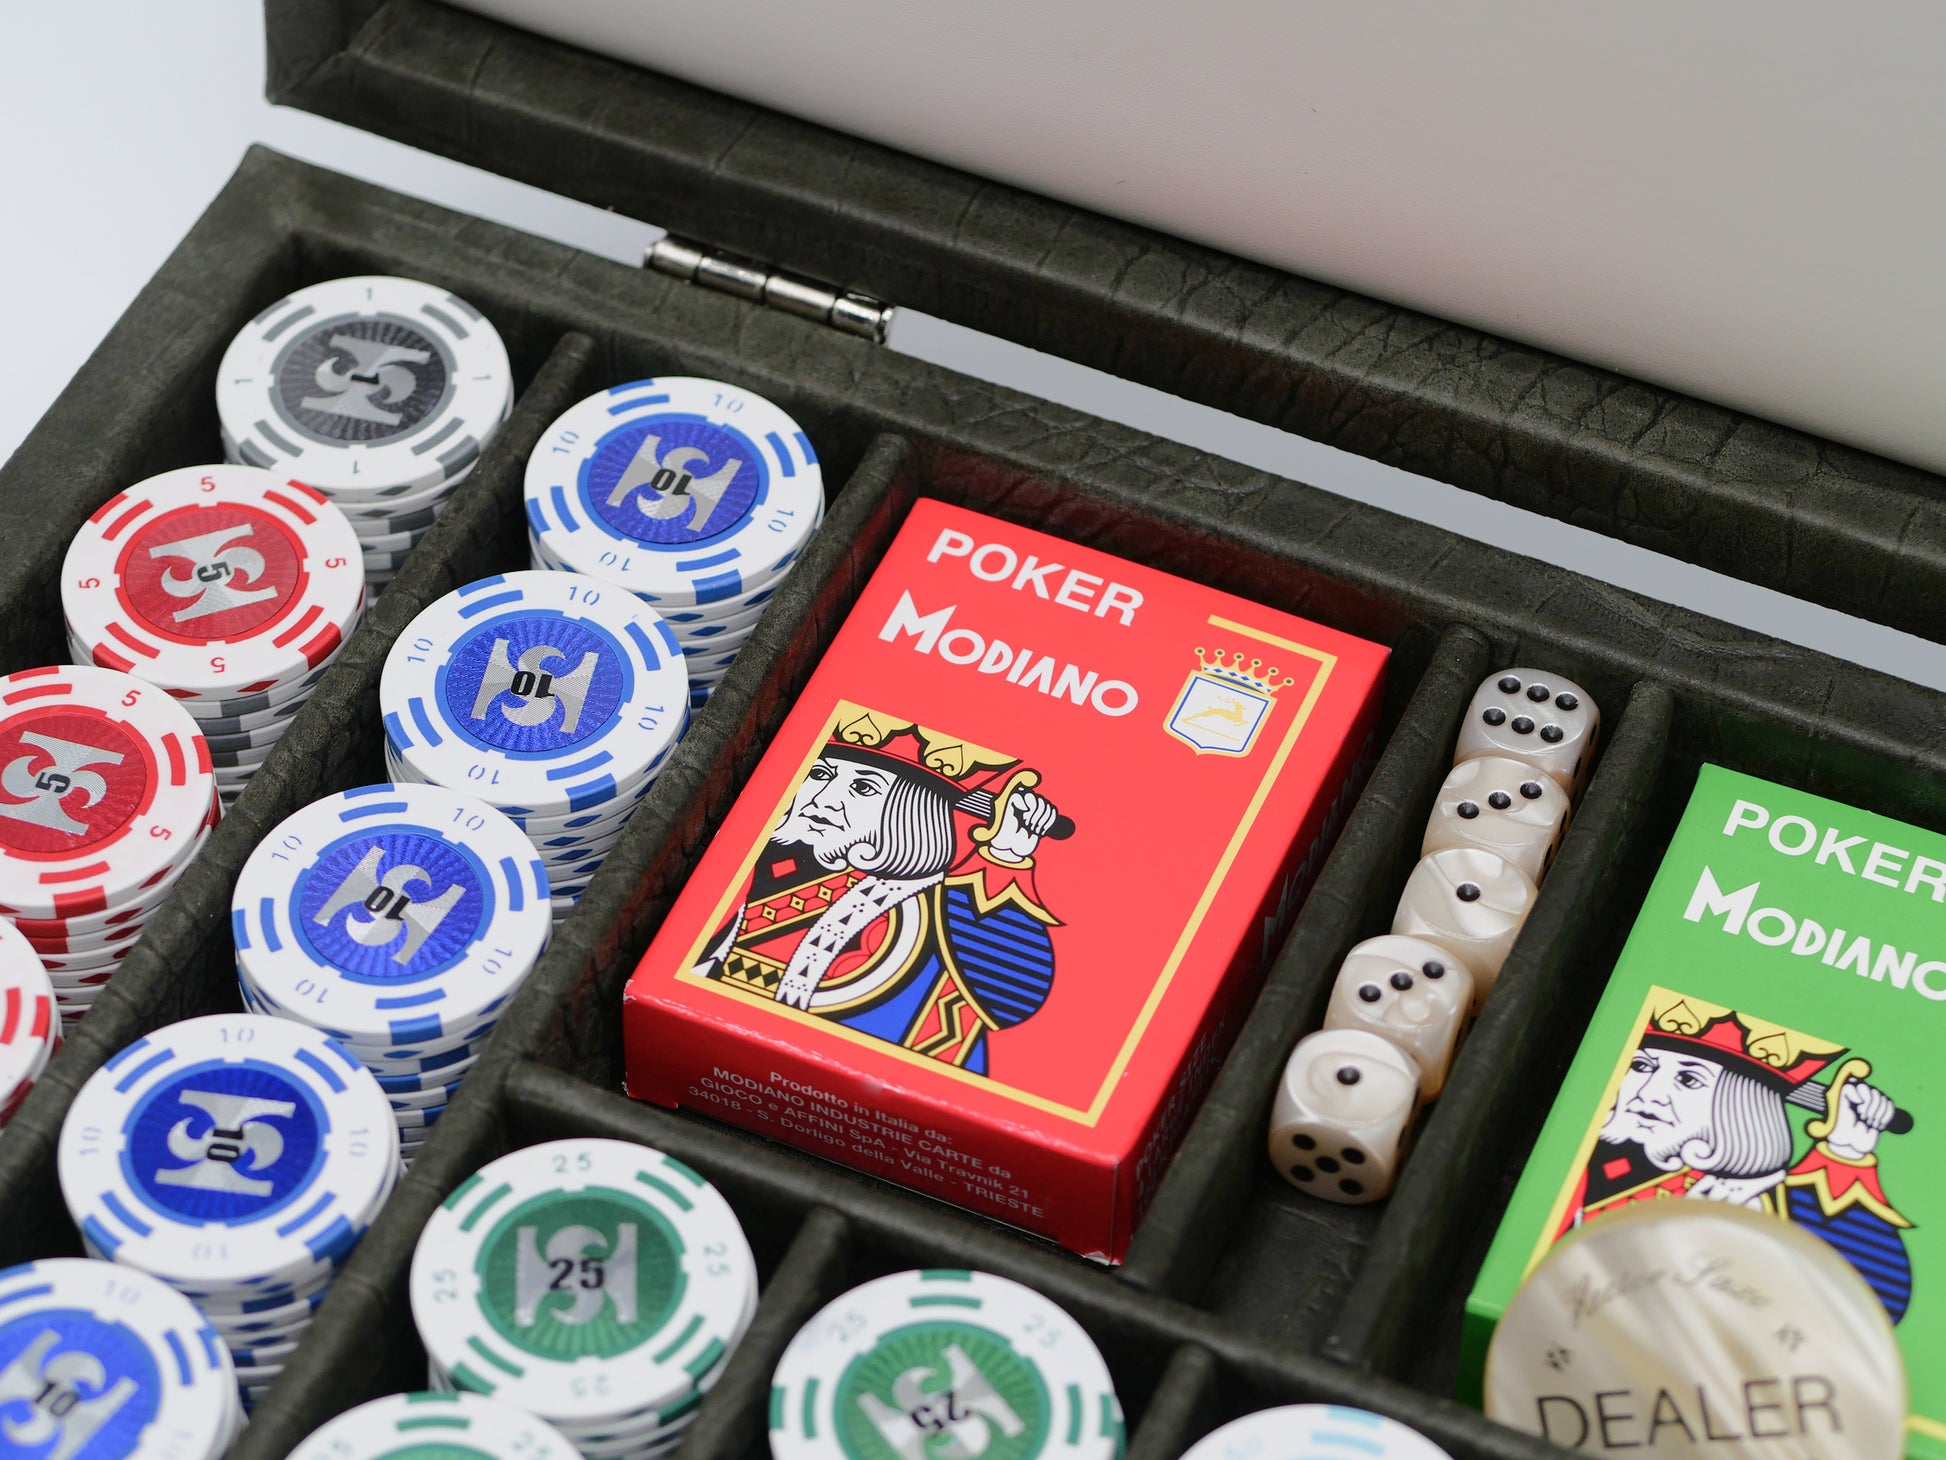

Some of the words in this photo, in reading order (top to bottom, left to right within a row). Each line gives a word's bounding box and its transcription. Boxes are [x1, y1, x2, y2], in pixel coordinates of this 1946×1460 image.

[366, 287, 374, 302] 1
[714, 392, 746, 414] 10
[552, 430, 581, 455] 10
[353, 460, 360, 475] 1
[201, 476, 216, 493] 5
[650, 468, 693, 498] 10
[768, 510, 795, 533] 10
[197, 561, 231, 583] 5
[325, 558, 347, 569] 5
[599, 552, 631, 572] 10
[79, 578, 101, 589] 5
[926, 528, 1144, 627] POKER
[569, 586, 601, 606] 10
[407, 638, 434, 663] 10
[878, 589, 1139, 717] MODIANO
[210, 657, 226, 674] 5
[509, 670, 556, 699] 10
[121, 690, 142, 708] 5
[638, 706, 665, 731] 10
[35, 772, 71, 794] 5
[468, 765, 500, 785] 10
[454, 808, 487, 832] 10
[150, 825, 173, 841] 5
[273, 835, 304, 862] 10
[1722, 799, 1946, 903] POKER
[363, 887, 413, 921] 10
[1683, 865, 1946, 1001] MODIANO
[482, 949, 513, 975] 10
[295, 979, 329, 1004] 10
[220, 1028, 256, 1045] 10
[770, 1072, 848, 1109] Prodotto
[853, 1102, 870, 1117] in
[875, 1110, 919, 1133] Italia
[924, 1129, 952, 1144] da:
[713, 1066, 805, 1107] MODIANO
[810, 1102, 913, 1145] INDUSTRIE
[918, 1140, 983, 1169] CARTE
[988, 1165, 1012, 1179] da
[79, 1126, 102, 1157] 10
[206, 1127, 245, 1164] 10
[700, 1077, 763, 1105] GIOCO
[768, 1102, 778, 1111] e
[784, 1107, 844, 1134] AFFINI
[849, 1128, 886, 1149] SpA
[903, 1147, 932, 1164] Via
[936, 1158, 1003, 1190] Travnik
[1009, 1185, 1029, 1199] 21
[552, 1152, 593, 1175] 25
[689, 1086, 742, 1111] 34018
[757, 1109, 775, 1122] S.
[780, 1117, 847, 1147] Dorligo
[851, 1143, 895, 1165] della
[901, 1159, 945, 1182] Valle
[963, 1181, 1044, 1218] TRIESTE
[432, 1269, 459, 1303] 25
[549, 1257, 605, 1290] 25
[35, 1382, 80, 1417] 10
[911, 1390, 970, 1438] 25
[1537, 1375, 1843, 1450] DEALER
